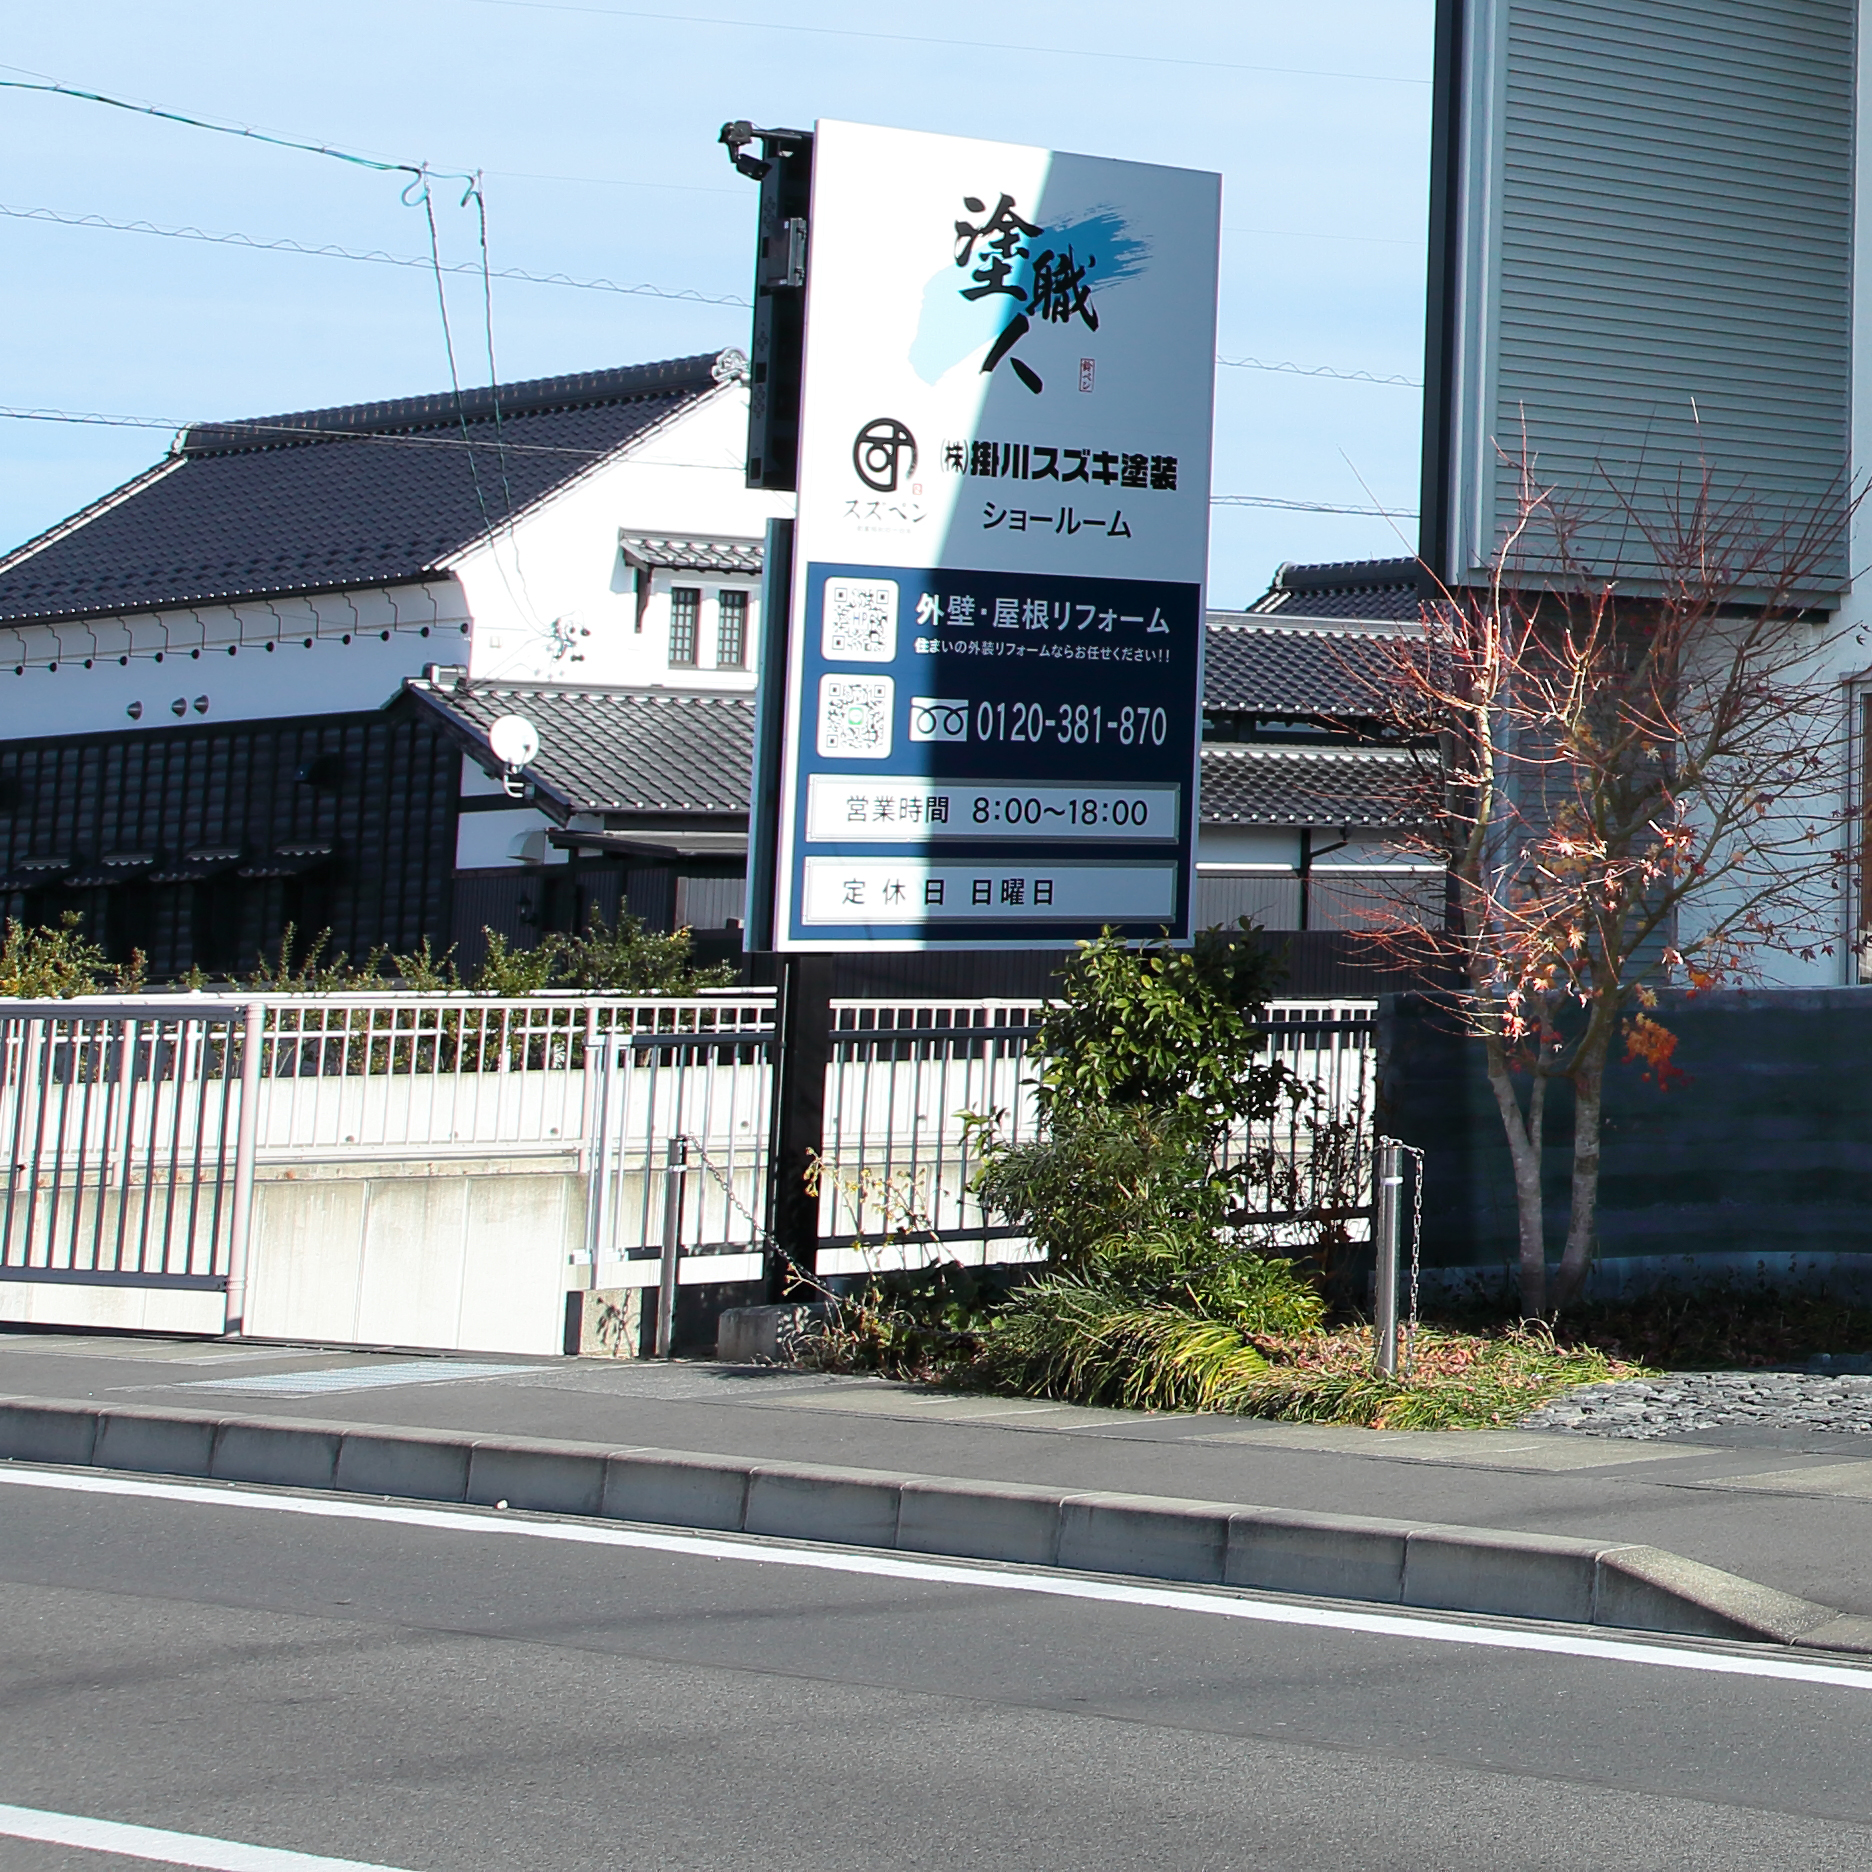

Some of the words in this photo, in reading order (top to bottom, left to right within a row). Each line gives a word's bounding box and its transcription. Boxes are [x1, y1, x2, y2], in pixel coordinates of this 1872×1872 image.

[982, 501, 1132, 539] ショールーム
[914, 592, 1170, 634] 外壁・屋根リフォーム
[976, 700, 1167, 746] 0120-381-870
[846, 795, 950, 824] 営業時間
[971, 878, 1054, 906] 日曜日
